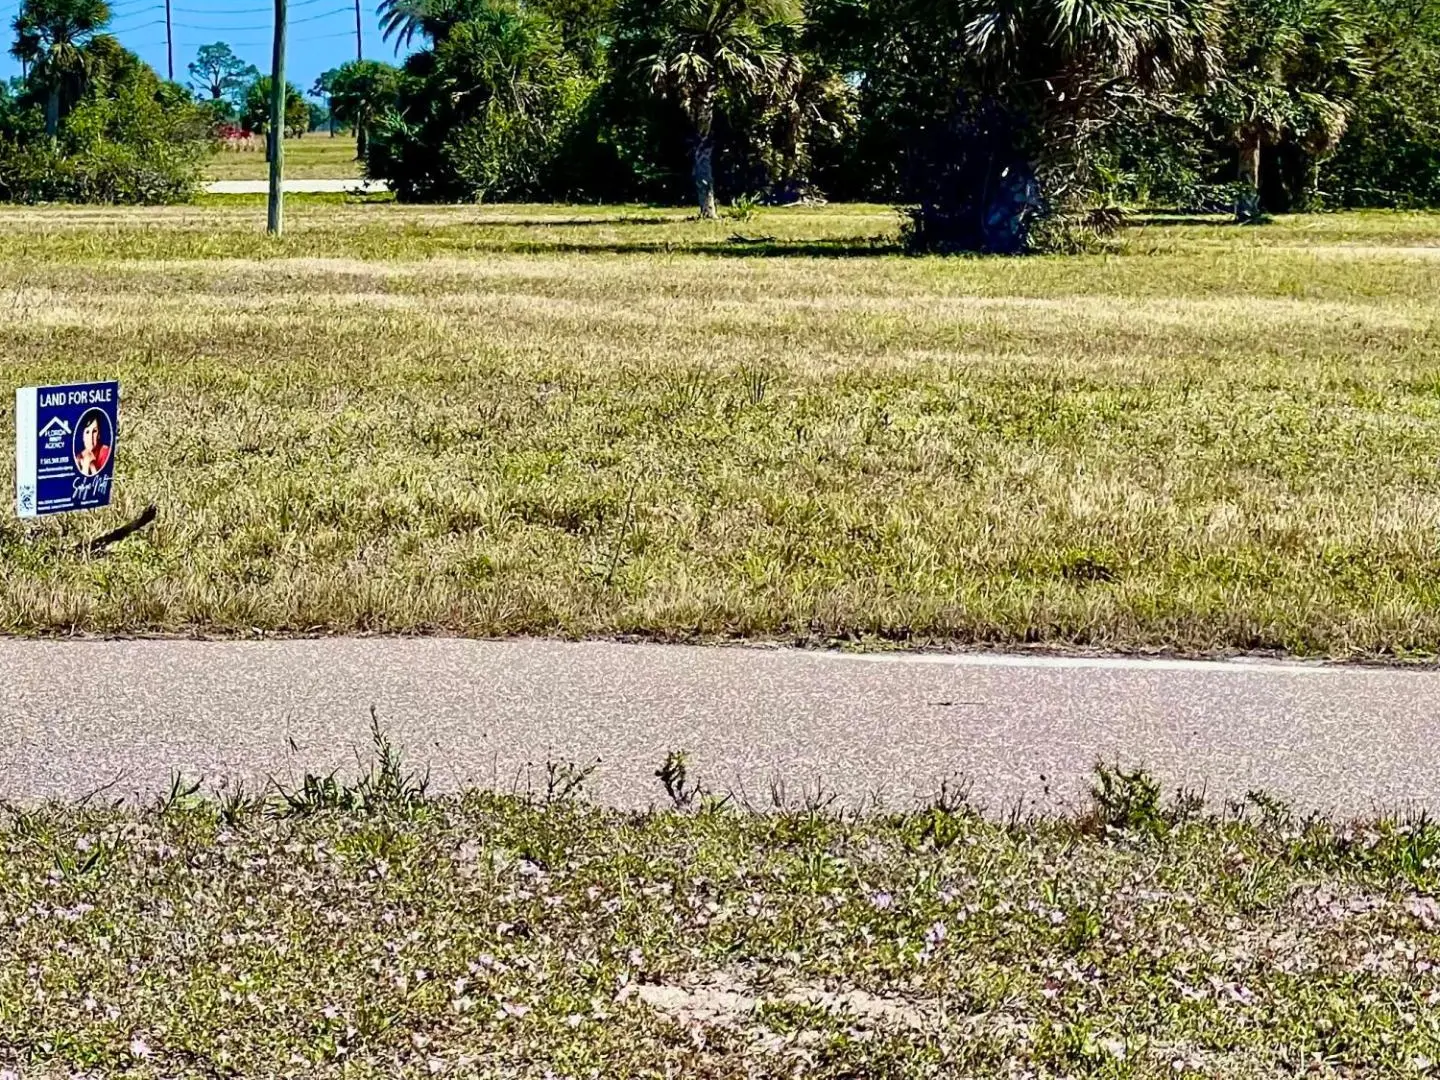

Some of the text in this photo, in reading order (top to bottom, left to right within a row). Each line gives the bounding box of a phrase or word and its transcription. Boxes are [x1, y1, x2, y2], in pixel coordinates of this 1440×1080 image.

[40, 389, 112, 407] LAND FOR SALE
[45, 441, 65, 449] AGENCY
